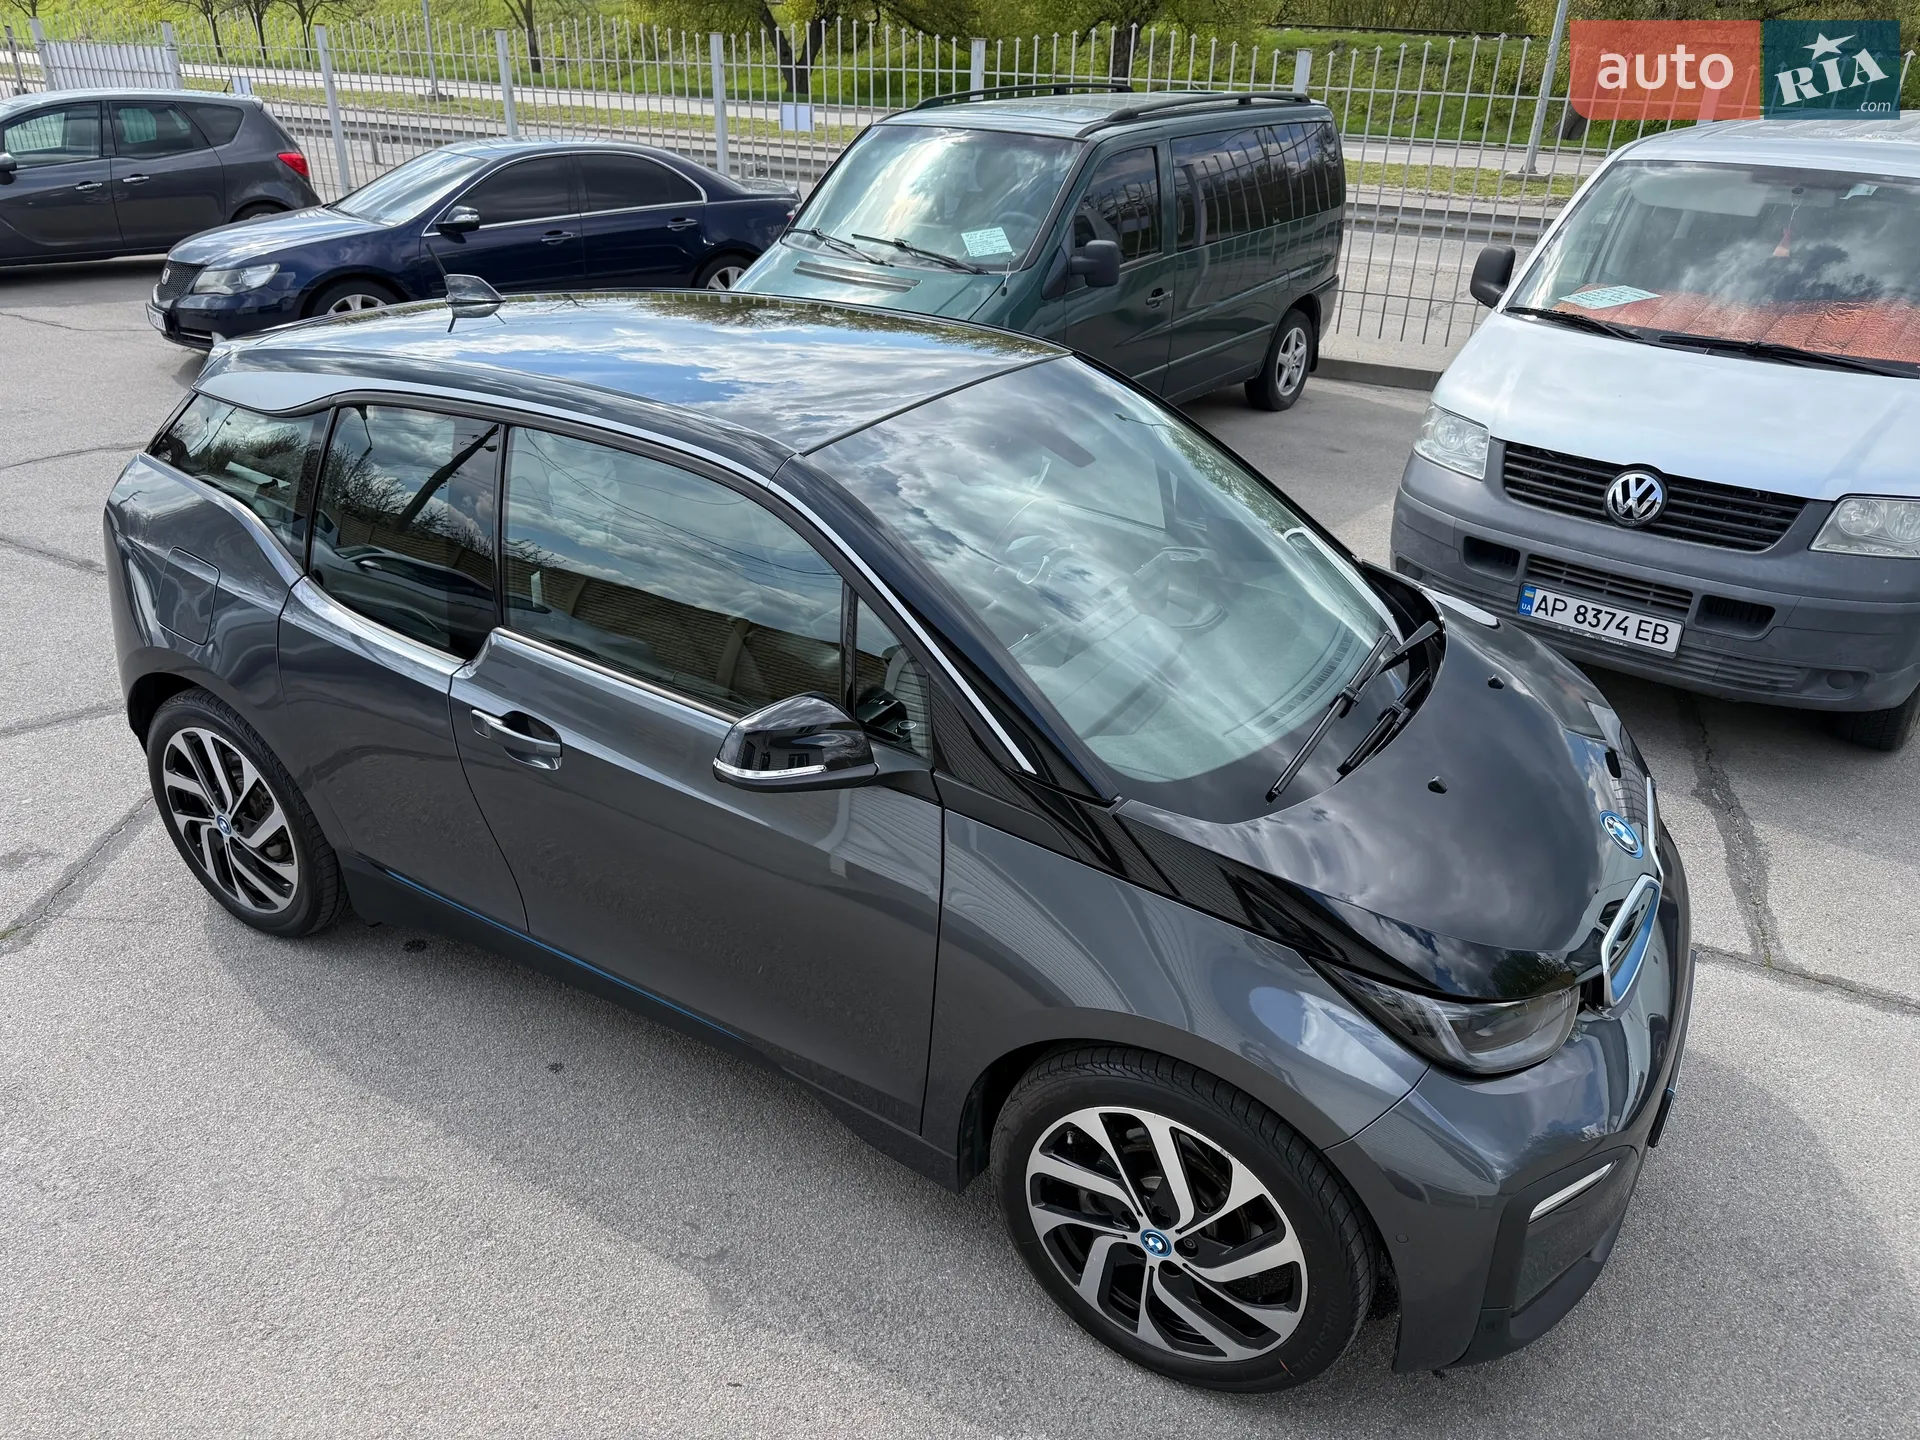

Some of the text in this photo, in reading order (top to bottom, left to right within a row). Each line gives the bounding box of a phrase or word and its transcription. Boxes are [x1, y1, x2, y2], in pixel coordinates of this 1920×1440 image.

[1521, 602, 1532, 612] UA
[1534, 594, 1568, 618] AP
[1573, 604, 1630, 637] 8374
[1635, 618, 1670, 645] EB
